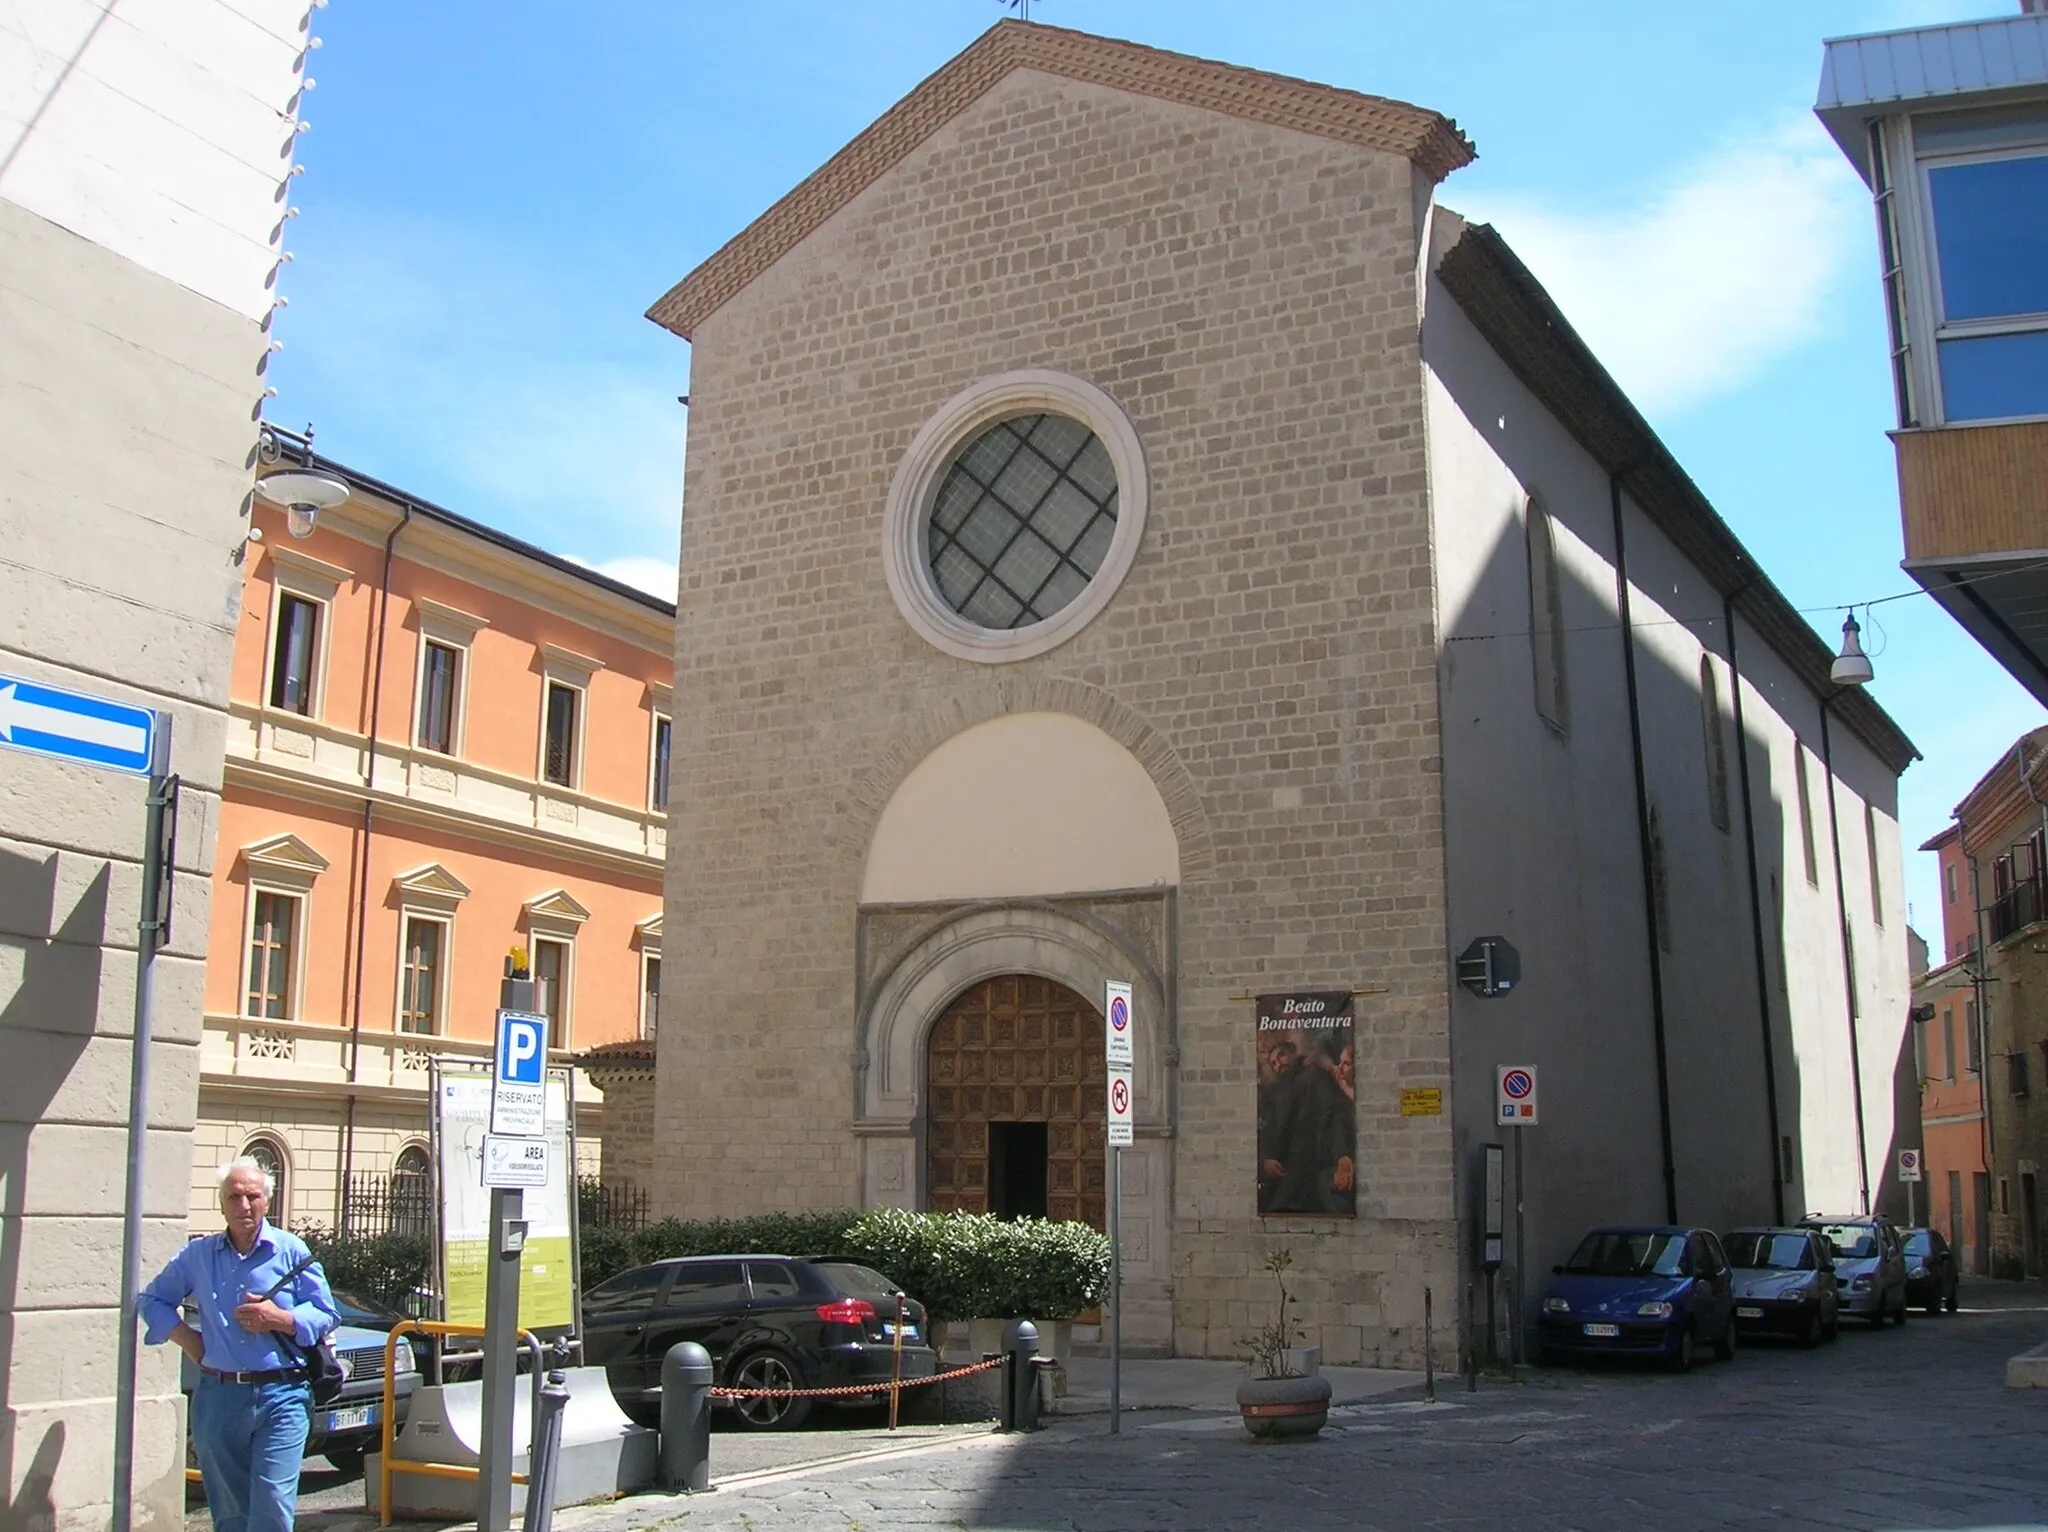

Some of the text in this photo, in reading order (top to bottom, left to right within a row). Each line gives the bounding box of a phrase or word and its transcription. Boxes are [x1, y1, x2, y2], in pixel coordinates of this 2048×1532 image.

[1283, 999, 1325, 1014] Beato
[1259, 1016, 1352, 1031] Bonaventura
[508, 1023, 537, 1078] P
[496, 1091, 543, 1105] RISERVATO
[1504, 1106, 1513, 1116] P
[525, 1146, 544, 1160] AREA
